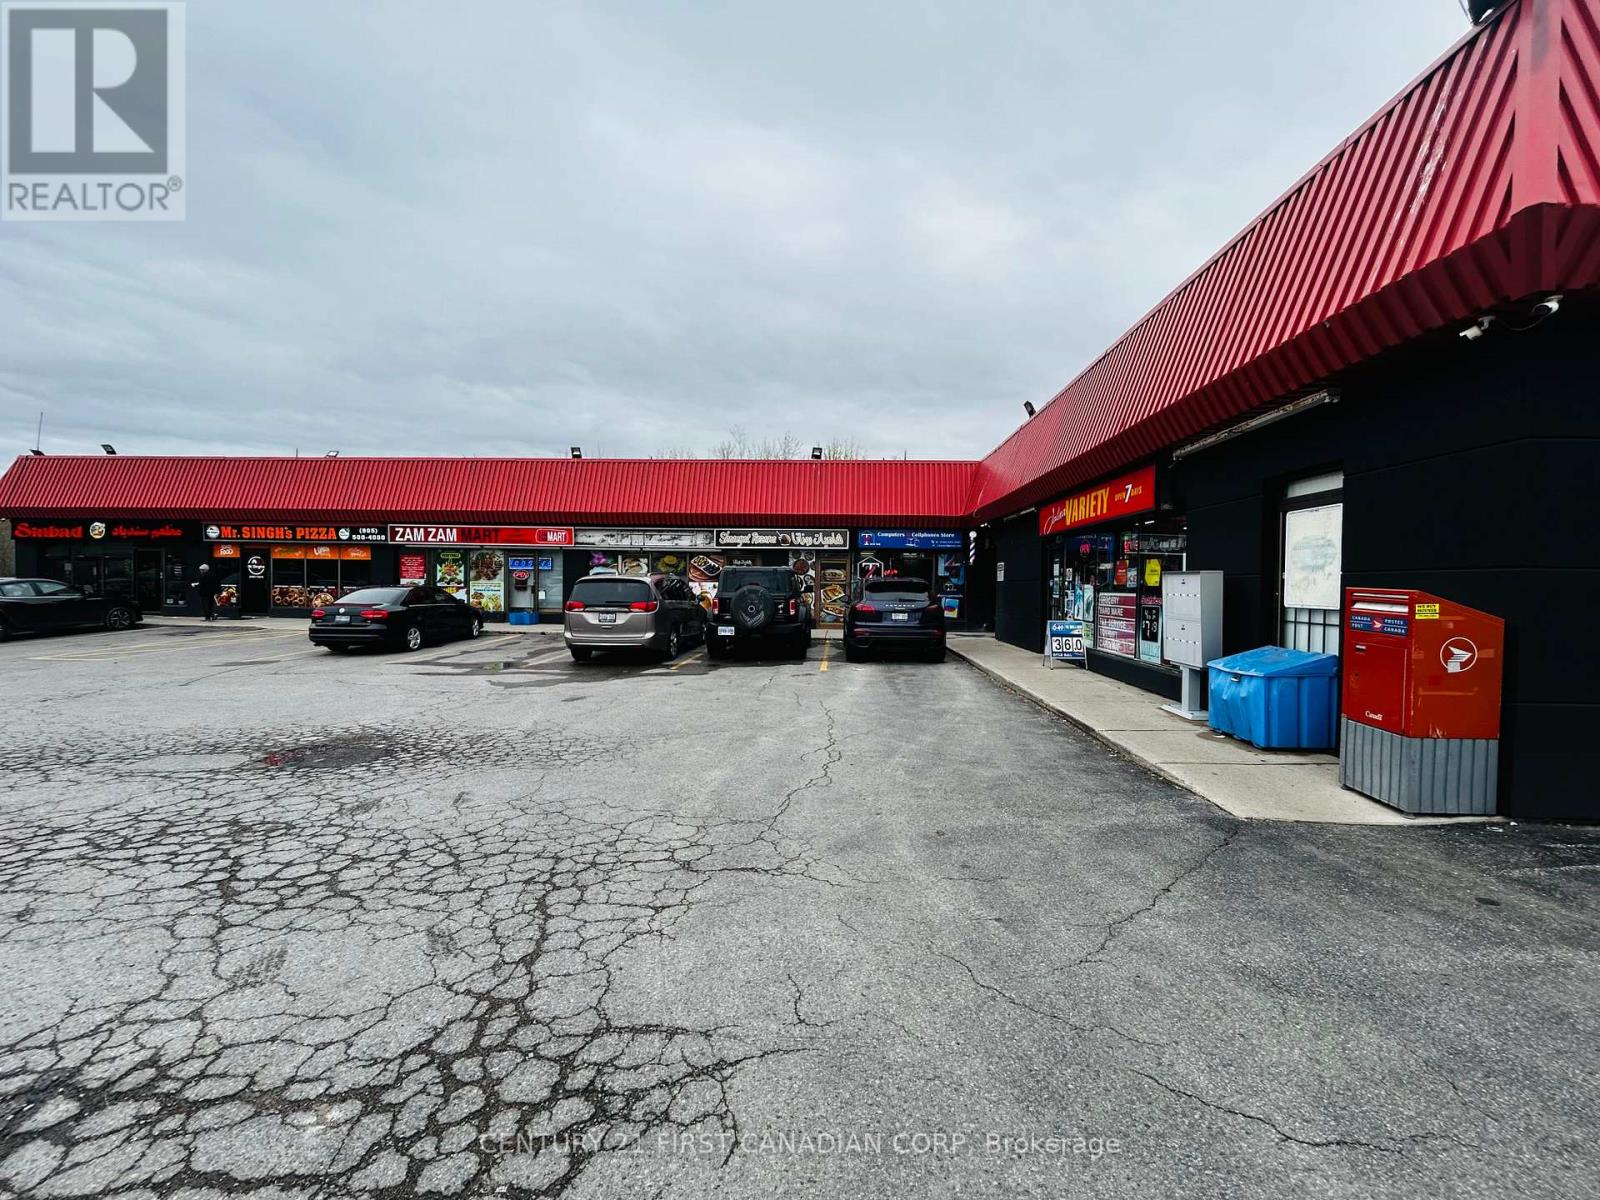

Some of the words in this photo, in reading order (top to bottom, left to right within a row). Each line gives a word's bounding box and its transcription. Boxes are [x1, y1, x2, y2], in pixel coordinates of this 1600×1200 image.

[1124, 484, 1133, 503] 7
[1065, 487, 1110, 526] VARIETY
[221, 526, 241, 539] Mr.
[242, 526, 293, 539] SINGH's
[295, 527, 337, 539] PIZZA
[395, 527, 424, 542] ZAM
[427, 527, 457, 542] ZAM
[460, 528, 500, 543] MART
[547, 531, 566, 542] MART
[1365, 710, 1383, 721] Canada
